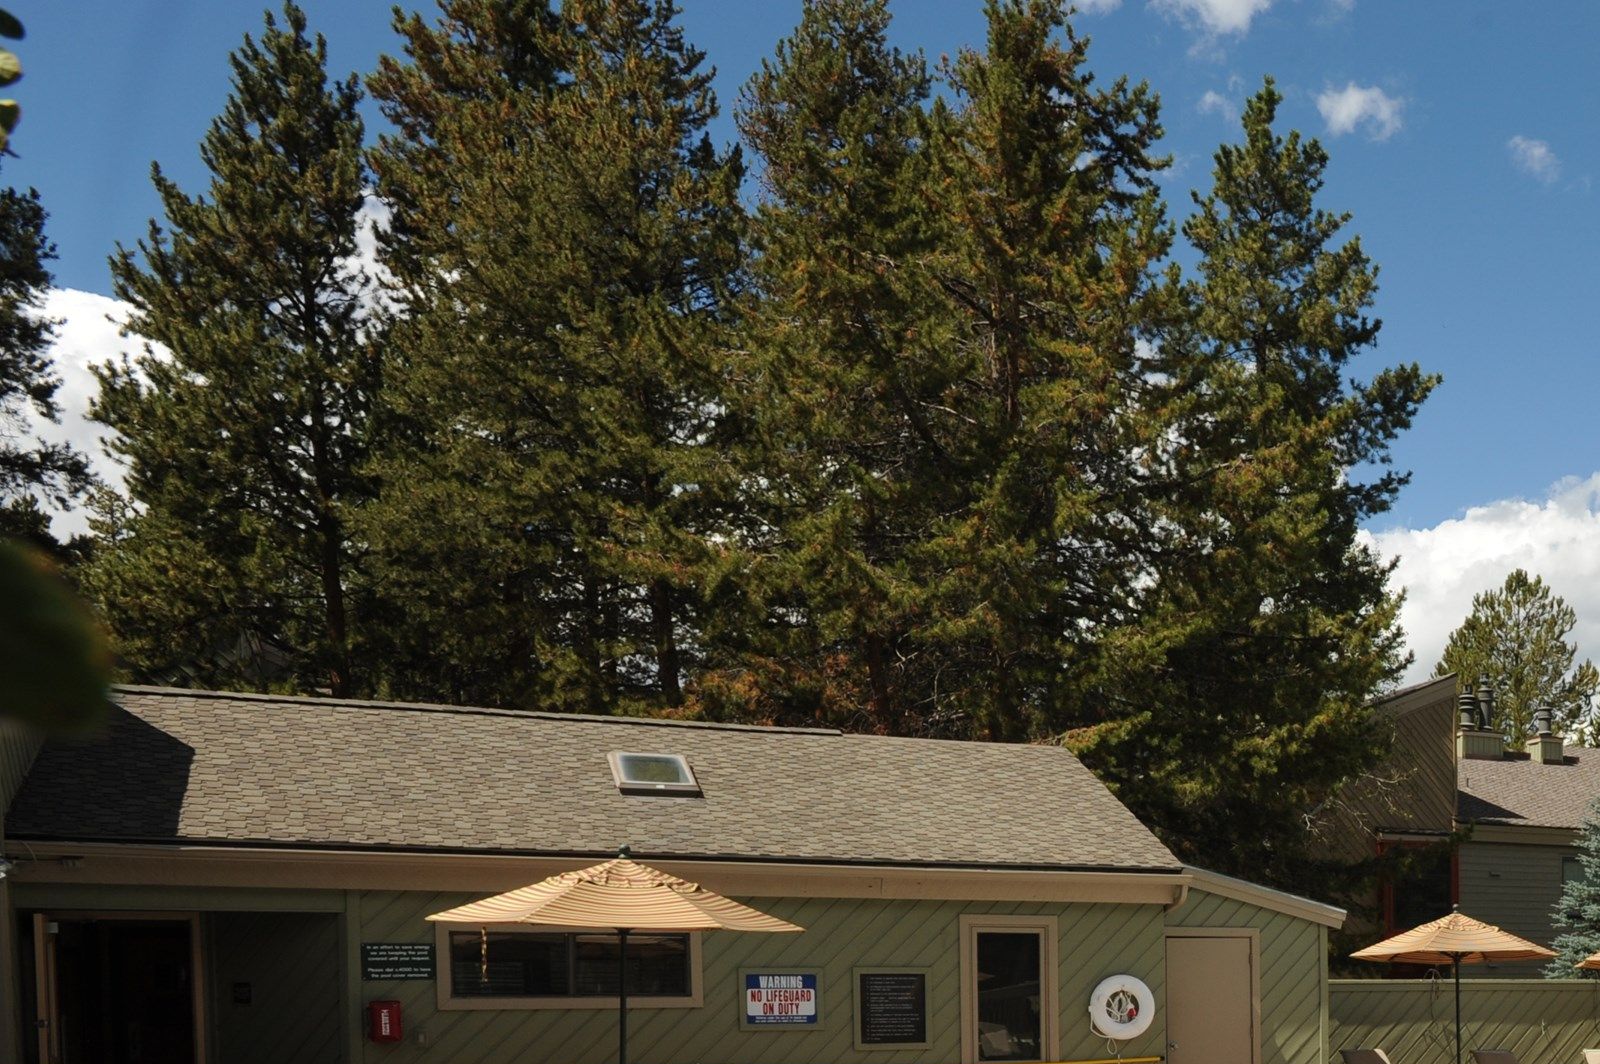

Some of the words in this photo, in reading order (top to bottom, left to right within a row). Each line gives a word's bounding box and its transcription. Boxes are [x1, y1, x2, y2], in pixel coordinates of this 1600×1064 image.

[759, 975, 803, 989] WARNING
[750, 990, 762, 1002] NO
[766, 990, 811, 1002] LIFEGUARD
[762, 1002, 774, 1014] ON
[778, 1003, 799, 1014] DUTY
